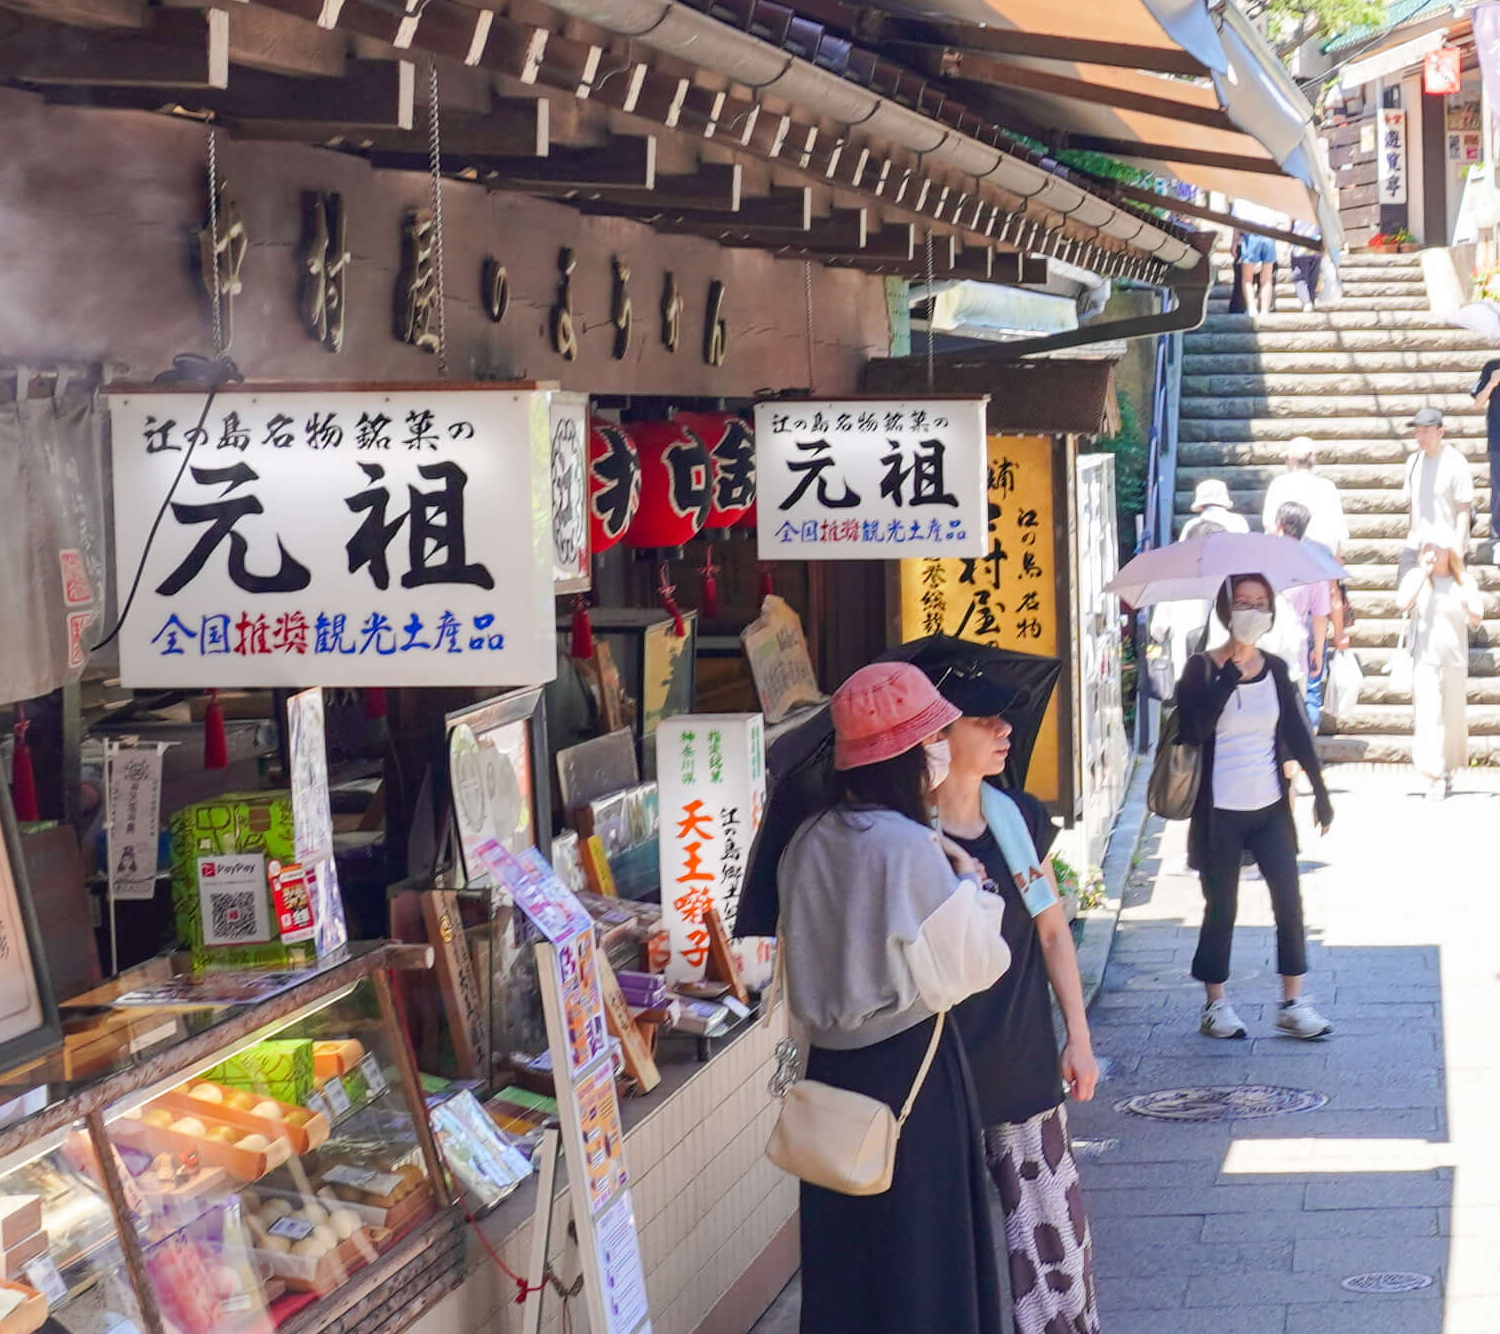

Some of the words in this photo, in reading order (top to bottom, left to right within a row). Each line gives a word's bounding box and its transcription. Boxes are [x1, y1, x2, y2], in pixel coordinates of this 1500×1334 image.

[142, 410, 476, 455] 江の島名物銘菓の
[771, 410, 950, 434] 江の島名物銘菓の
[778, 438, 960, 511] 元祖
[155, 461, 495, 597] 元祖
[774, 518, 967, 544] 全国推奨観光土産品
[1016, 506, 1044, 640] 江の島名物
[150, 611, 505, 657] 全国推奨観光土産品
